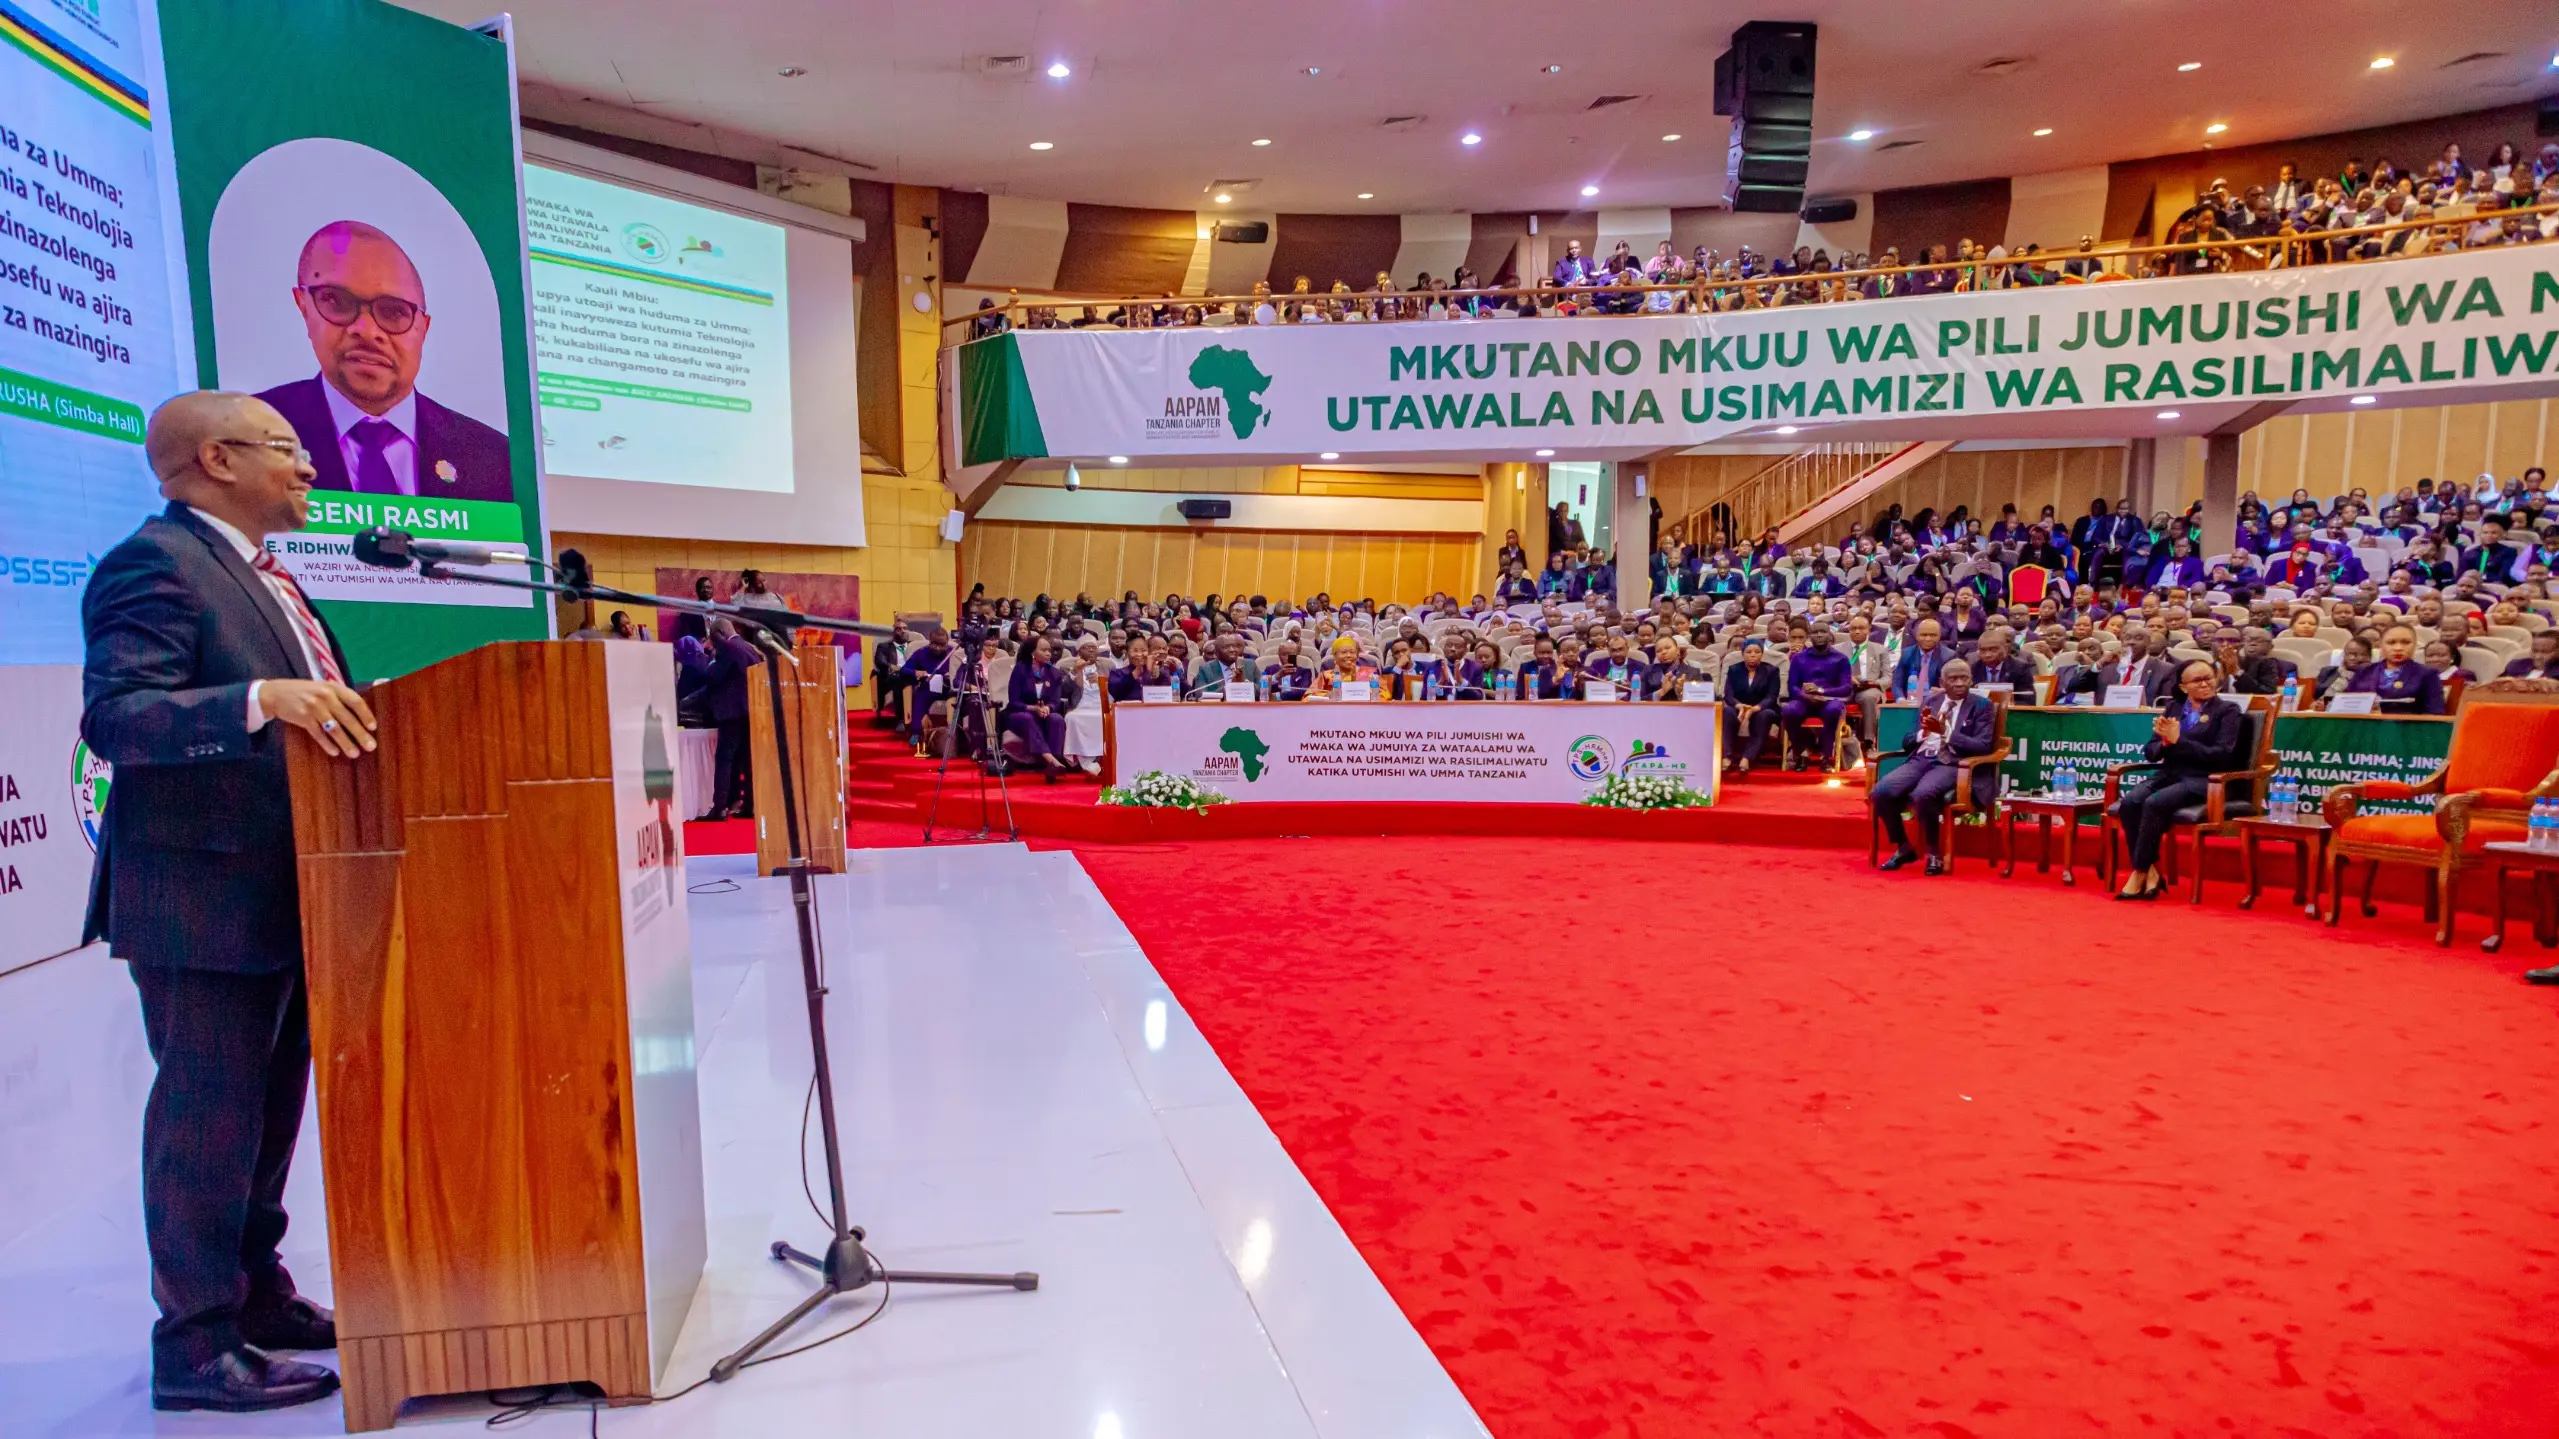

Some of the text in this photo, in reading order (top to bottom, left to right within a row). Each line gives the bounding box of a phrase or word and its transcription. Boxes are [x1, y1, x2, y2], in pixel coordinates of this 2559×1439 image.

[25, 139, 48, 168] za
[53, 149, 123, 209] Umma;
[31, 179, 133, 249] Teknolojia
[551, 213, 609, 233] UTAWALA
[574, 207, 594, 219] WA
[527, 219, 599, 241] IMALIWATU
[0, 210, 116, 282] zinazolenga
[550, 234, 612, 254] TANZANIA
[57, 282, 86, 309] wa
[92, 293, 133, 324] ajira
[585, 282, 659, 305] Kauli Mbiu:
[536, 290, 571, 304] upya
[575, 296, 613, 312] utoaji
[617, 304, 636, 314] wa
[639, 306, 691, 324] huduma
[694, 318, 707, 328] za
[3, 304, 130, 364] za mazingira
[560, 306, 637, 329] inavyoweza
[641, 321, 692, 338] kutumia
[696, 331, 756, 350] Teknolojia
[1390, 339, 1641, 381] MKUTANO
[1659, 330, 1808, 374] MKUU
[1826, 323, 1919, 364] WA
[1938, 315, 2040, 358] PILI
[2059, 290, 2360, 351] JUMUISHI
[2385, 276, 2505, 327] WA
[561, 322, 617, 339] huduma
[620, 332, 650, 345] bora
[653, 338, 669, 348] na
[672, 341, 743, 361] zinazolenga
[553, 336, 631, 356] kukabiliana
[634, 349, 650, 359] na
[653, 352, 702, 367] ukosefu
[705, 361, 722, 370] wa
[725, 363, 751, 375] ajira
[567, 355, 584, 364] na
[587, 356, 669, 376] changamoto
[672, 369, 685, 378] za
[689, 371, 747, 388] mazingira
[1327, 330, 2559, 431] UTAWALA NA USIMAMIZI WA RASILIMALIW
[55, 395, 105, 426] (Simba
[108, 409, 140, 437] Hall)
[1164, 396, 1220, 417] AAPAM
[1146, 418, 1221, 430] TANZANIA CHAPTER
[384, 505, 469, 531] RASMI
[287, 541, 355, 556] RIDHIW
[304, 562, 341, 571] WAZIRI
[344, 563, 361, 572] WA
[311, 574, 324, 582] YA
[327, 575, 375, 584] UTUMISHI
[378, 576, 395, 584] WA
[397, 576, 427, 585] UMMA
[1310, 730, 1525, 740] MKUTANO MKUU WA PILI JUMUISHI WA
[1300, 742, 1535, 753] MWAKA WA JUMUIYA ZA WATAALAMU WA
[2041, 740, 2110, 753] KUFIKIRIA
[2115, 743, 2145, 755] UPY
[1204, 756, 1238, 769] AAPAM
[1288, 755, 1343, 763] UTAWALA
[1366, 756, 1425, 764] USIMAMIZI
[1428, 756, 1446, 765] WA
[1450, 757, 1548, 766] RASILIMALIWATU
[2320, 751, 2342, 764] ZA
[2348, 753, 2403, 769] UMMA;
[1308, 768, 1527, 778] KATIKA UTUMISHI WA UMMA TANZANIA
